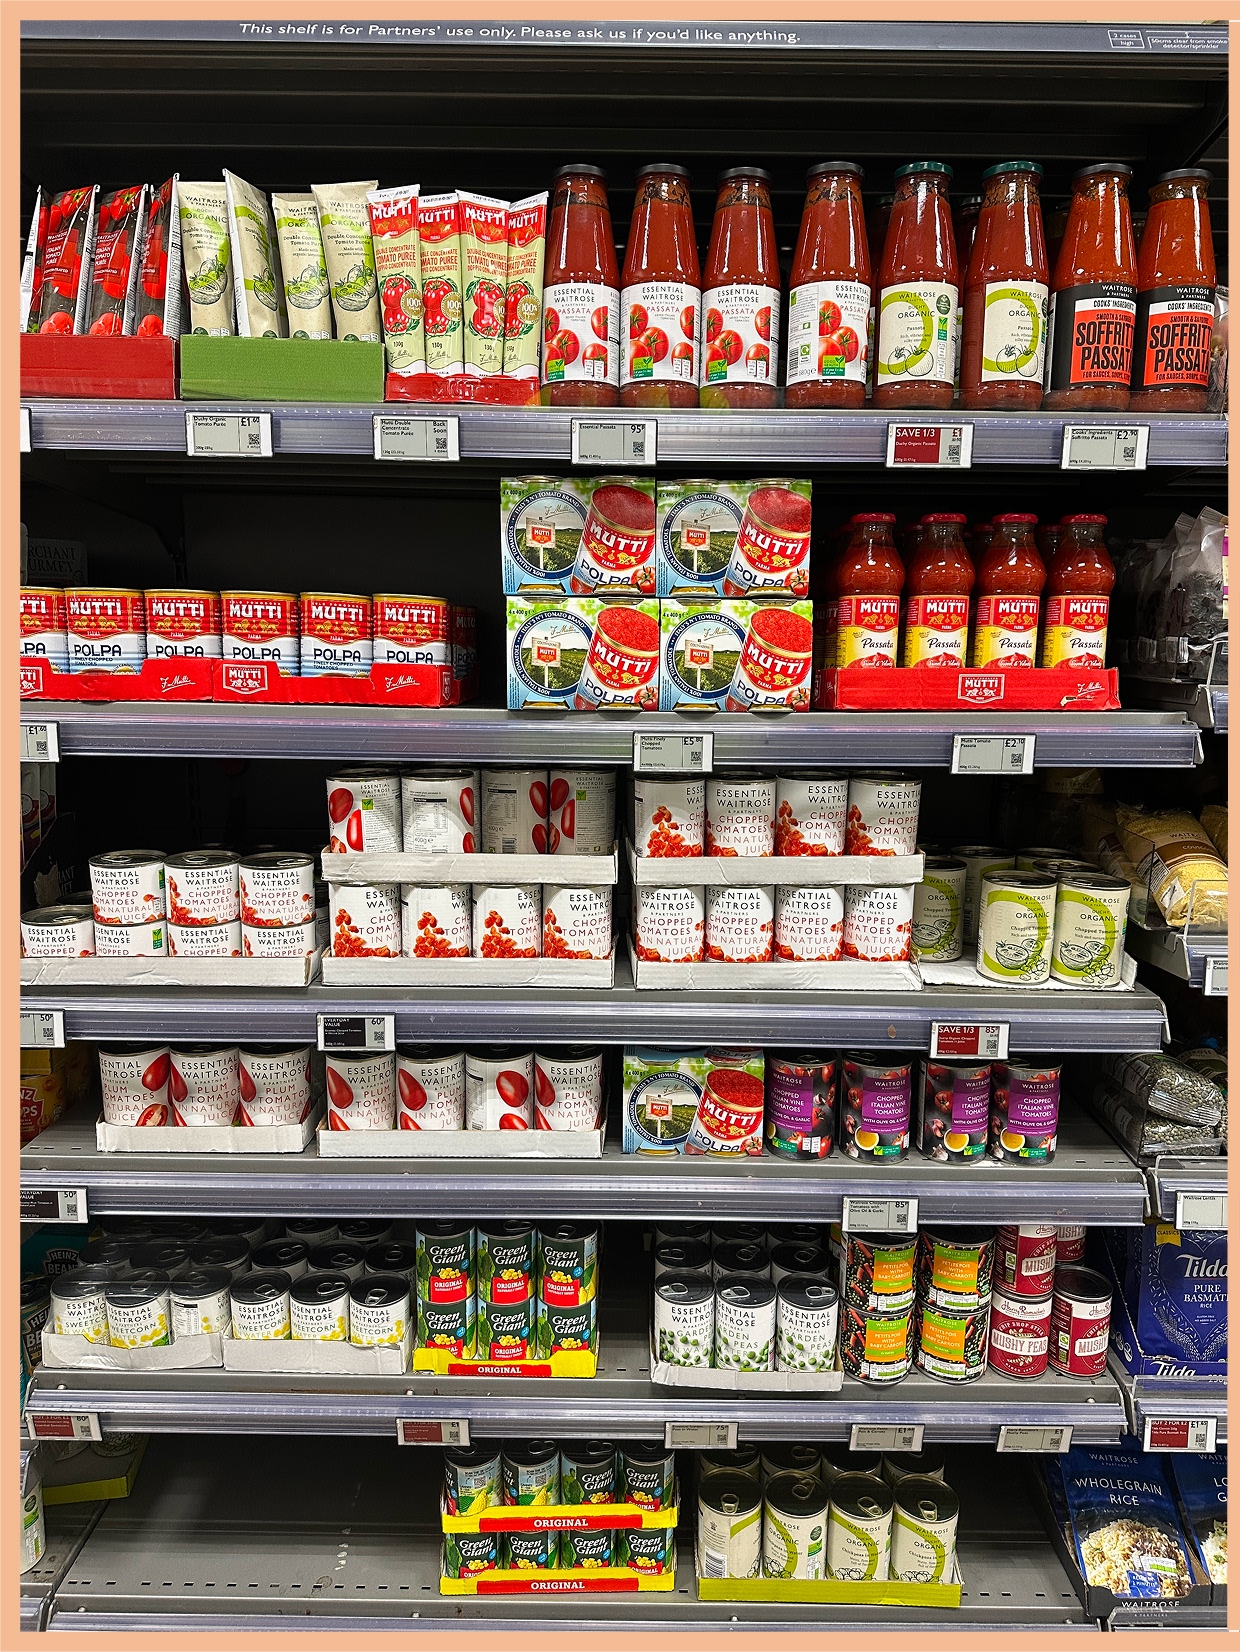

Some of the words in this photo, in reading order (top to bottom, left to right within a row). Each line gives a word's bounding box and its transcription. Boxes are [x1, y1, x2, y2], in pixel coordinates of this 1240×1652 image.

[240, 24, 273, 34] This
[278, 24, 318, 35] shelf
[322, 24, 334, 35] is
[339, 25, 363, 36] for
[446, 28, 474, 36] use
[480, 26, 517, 40] only.
[520, 26, 572, 38] Please
[578, 27, 603, 39] ask
[609, 30, 626, 39] us
[632, 28, 644, 39] if
[695, 29, 723, 40] like
[728, 30, 801, 44] anything.
[185, 196, 226, 208] WAITROSE
[185, 212, 227, 223] ORGANIC
[372, 203, 413, 220] MUTTI
[466, 206, 506, 226] MUTTI
[508, 212, 538, 230] MUTTI
[642, 286, 684, 294] ESSENTIAL
[898, 290, 936, 298] WAITROSE
[1102, 284, 1134, 292] WAITROSE
[1176, 287, 1210, 296] WAITROSE
[642, 294, 684, 302] WAITROSE
[898, 310, 936, 319] ORGANIC
[896, 428, 918, 438] SAVE
[920, 428, 936, 438] 1/3
[589, 520, 647, 554] MUTTI
[744, 525, 802, 557] MUTTI
[580, 558, 631, 586] POLPA
[70, 600, 122, 616] MUTTI
[230, 604, 282, 619] MUTTI
[312, 605, 363, 622] MUTTI
[860, 602, 898, 614] MUTTI
[998, 602, 1037, 614] MUTTI
[385, 607, 436, 624] MUTTI
[860, 637, 894, 650] Passata
[998, 637, 1033, 650] Passata
[74, 644, 122, 657] POLPA
[232, 647, 281, 660] POLPA
[314, 648, 362, 662] POLPA
[747, 642, 804, 675] MUTTI
[964, 679, 998, 688] MUTTI
[185, 868, 233, 878] ESSENTIAL
[186, 876, 233, 886] WAITROSE
[188, 888, 232, 898] CHOPPED
[1018, 894, 1052, 902] WAITROSE
[180, 896, 230, 906] TOMATOES
[1080, 914, 1118, 922] ORGANIC
[938, 1026, 961, 1034] SAVE
[963, 1026, 974, 1034] 1/3
[198, 1083, 228, 1094] PLUM
[1018, 1104, 1038, 1112] ITALIAN
[203, 1108, 234, 1123] JUICE
[51, 1250, 78, 1261] HEINZ
[430, 1243, 464, 1256] Green
[432, 1250, 466, 1264] Giant
[938, 1269, 950, 1277] BABY
[434, 1280, 463, 1288] ORIGINAL
[1194, 1284, 1222, 1293] PURE
[992, 1332, 1026, 1352] MUSHY
[1027, 1336, 1048, 1352] PEAS
[478, 1366, 522, 1374] ORIGINAL
[1150, 1361, 1196, 1376] Tilda
[1088, 1452, 1139, 1464] WAITROSE
[626, 1468, 658, 1481] Green
[628, 1477, 660, 1489] Giant
[1074, 1477, 1162, 1496] WHOLEGRAIN
[1109, 1494, 1140, 1506] RICE
[534, 1518, 589, 1528] ORIGINAL
[914, 1540, 948, 1550] ORGANIC
